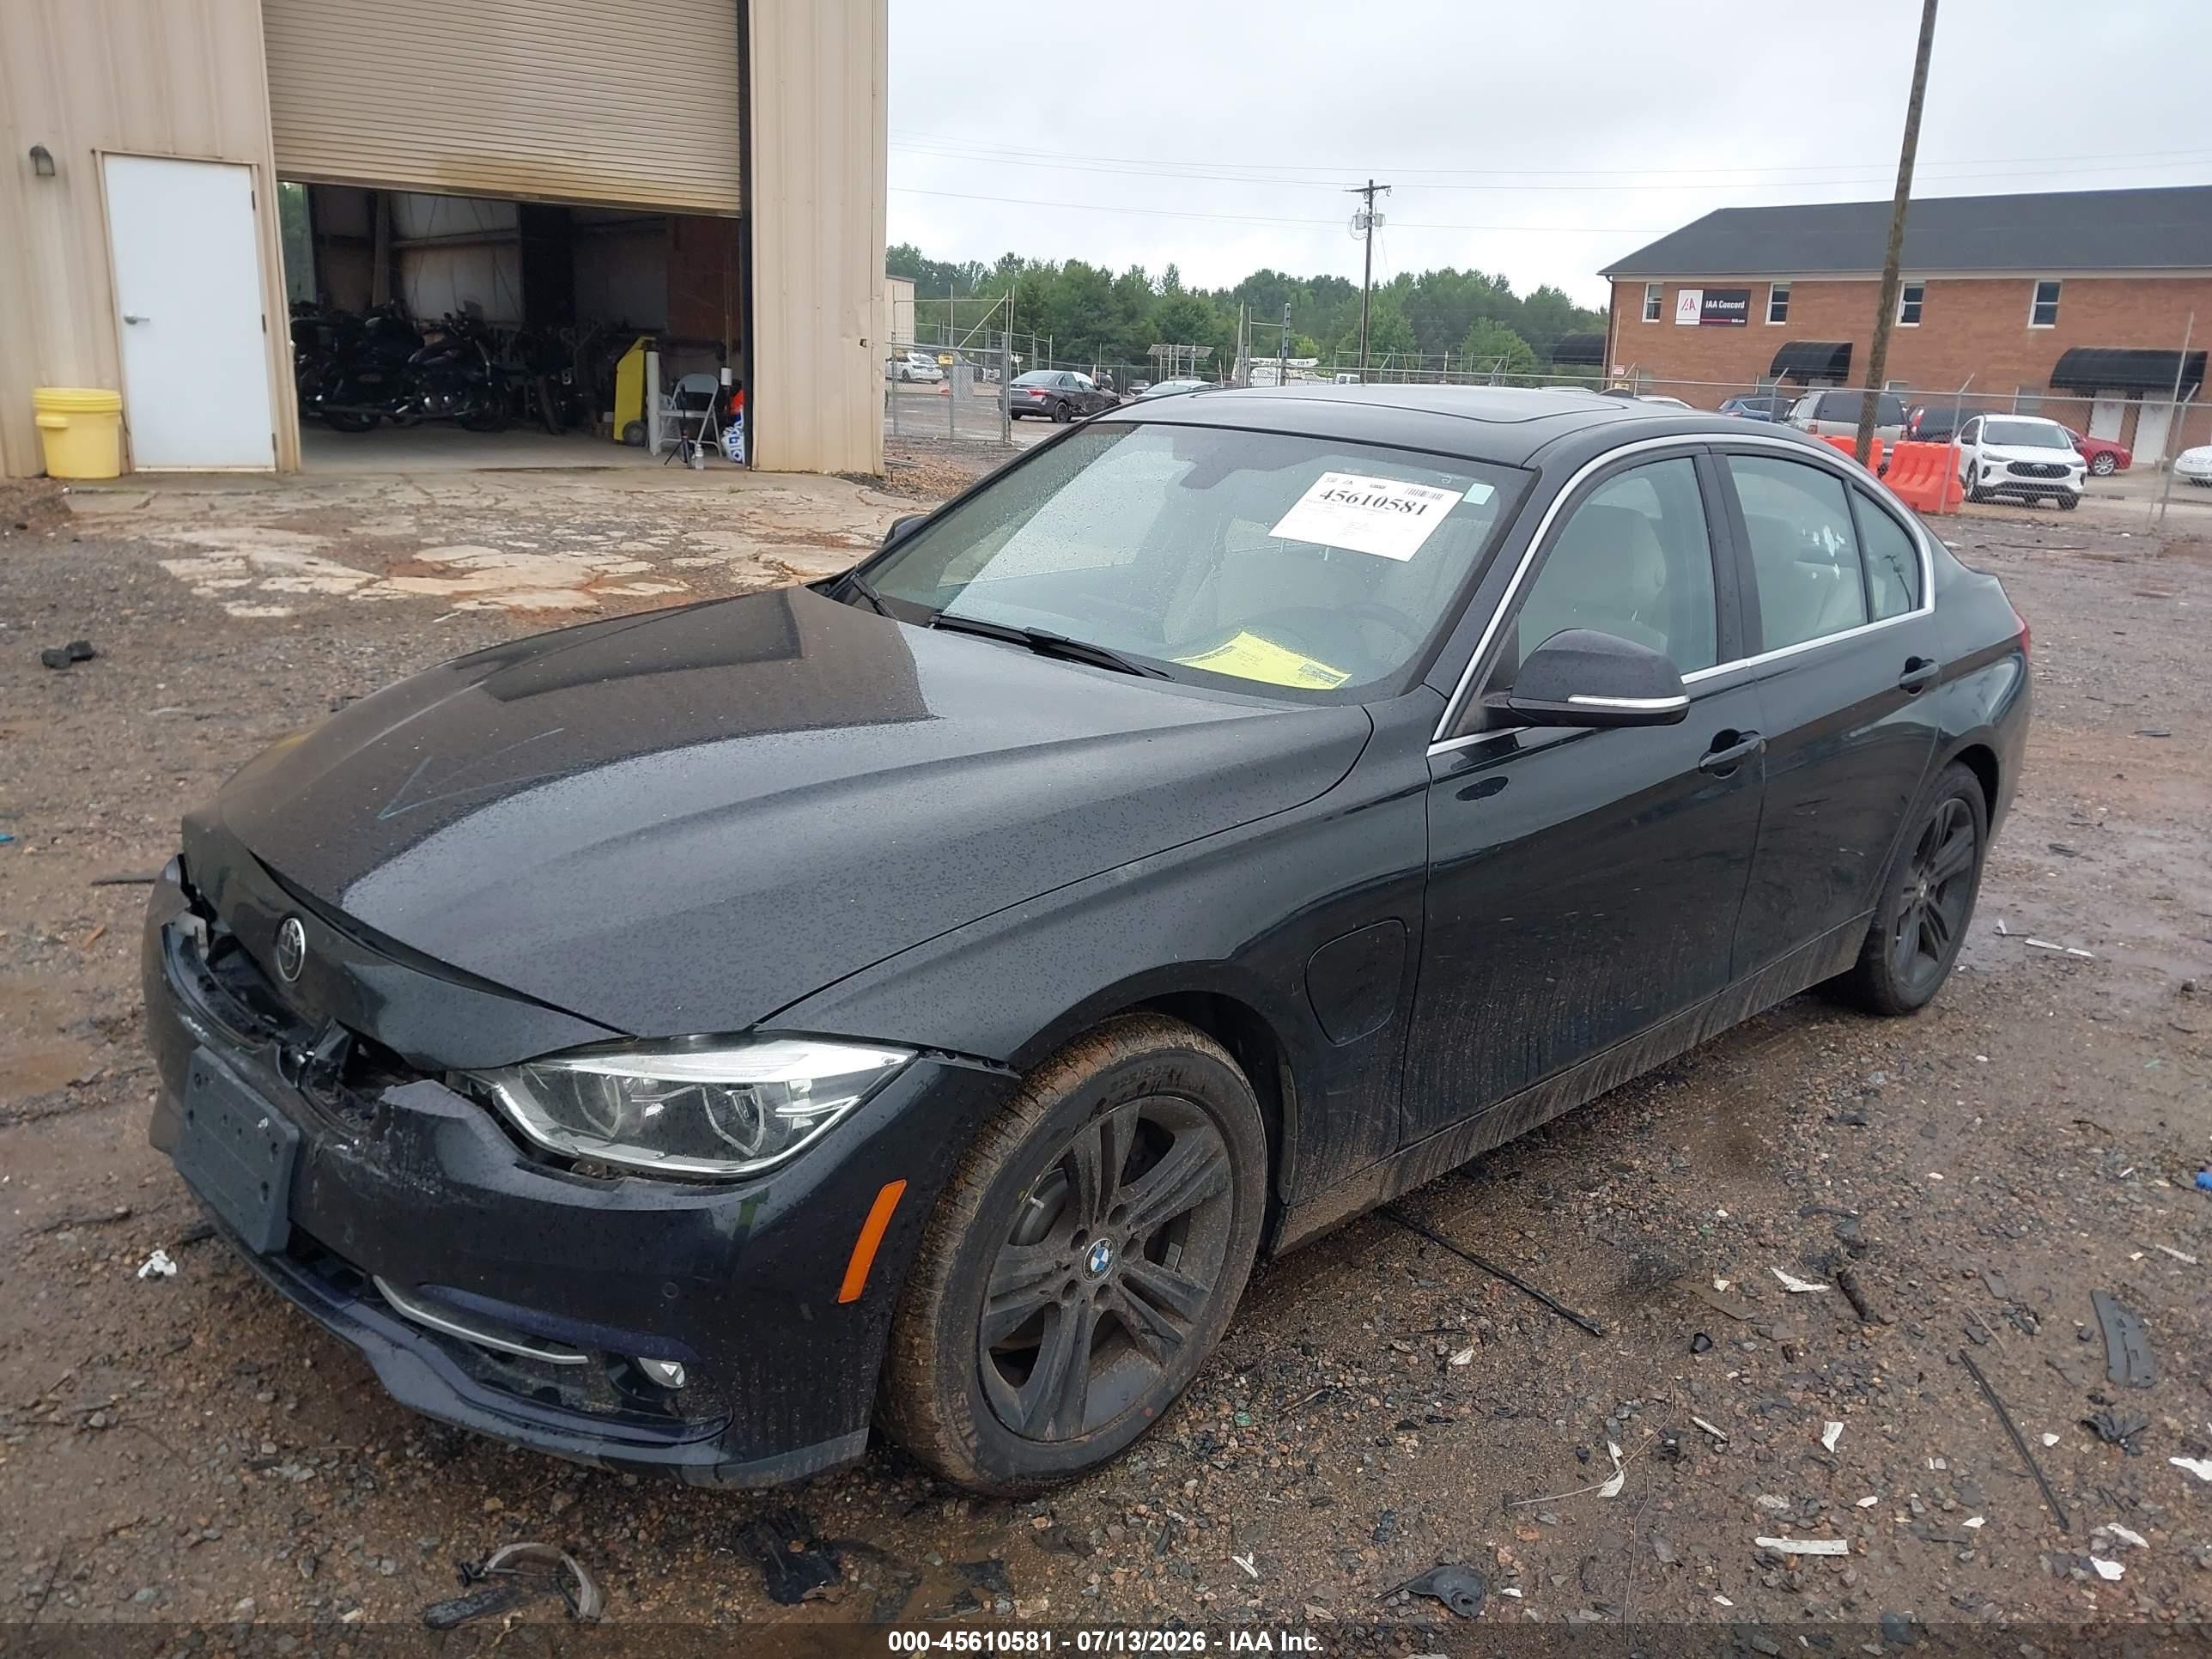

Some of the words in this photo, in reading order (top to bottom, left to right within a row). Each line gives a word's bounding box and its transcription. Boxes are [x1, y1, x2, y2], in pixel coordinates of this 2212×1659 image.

[1705, 300, 1717, 309] IAA
[1719, 300, 1745, 309] Concord
[1320, 489, 1429, 516] 45610581
